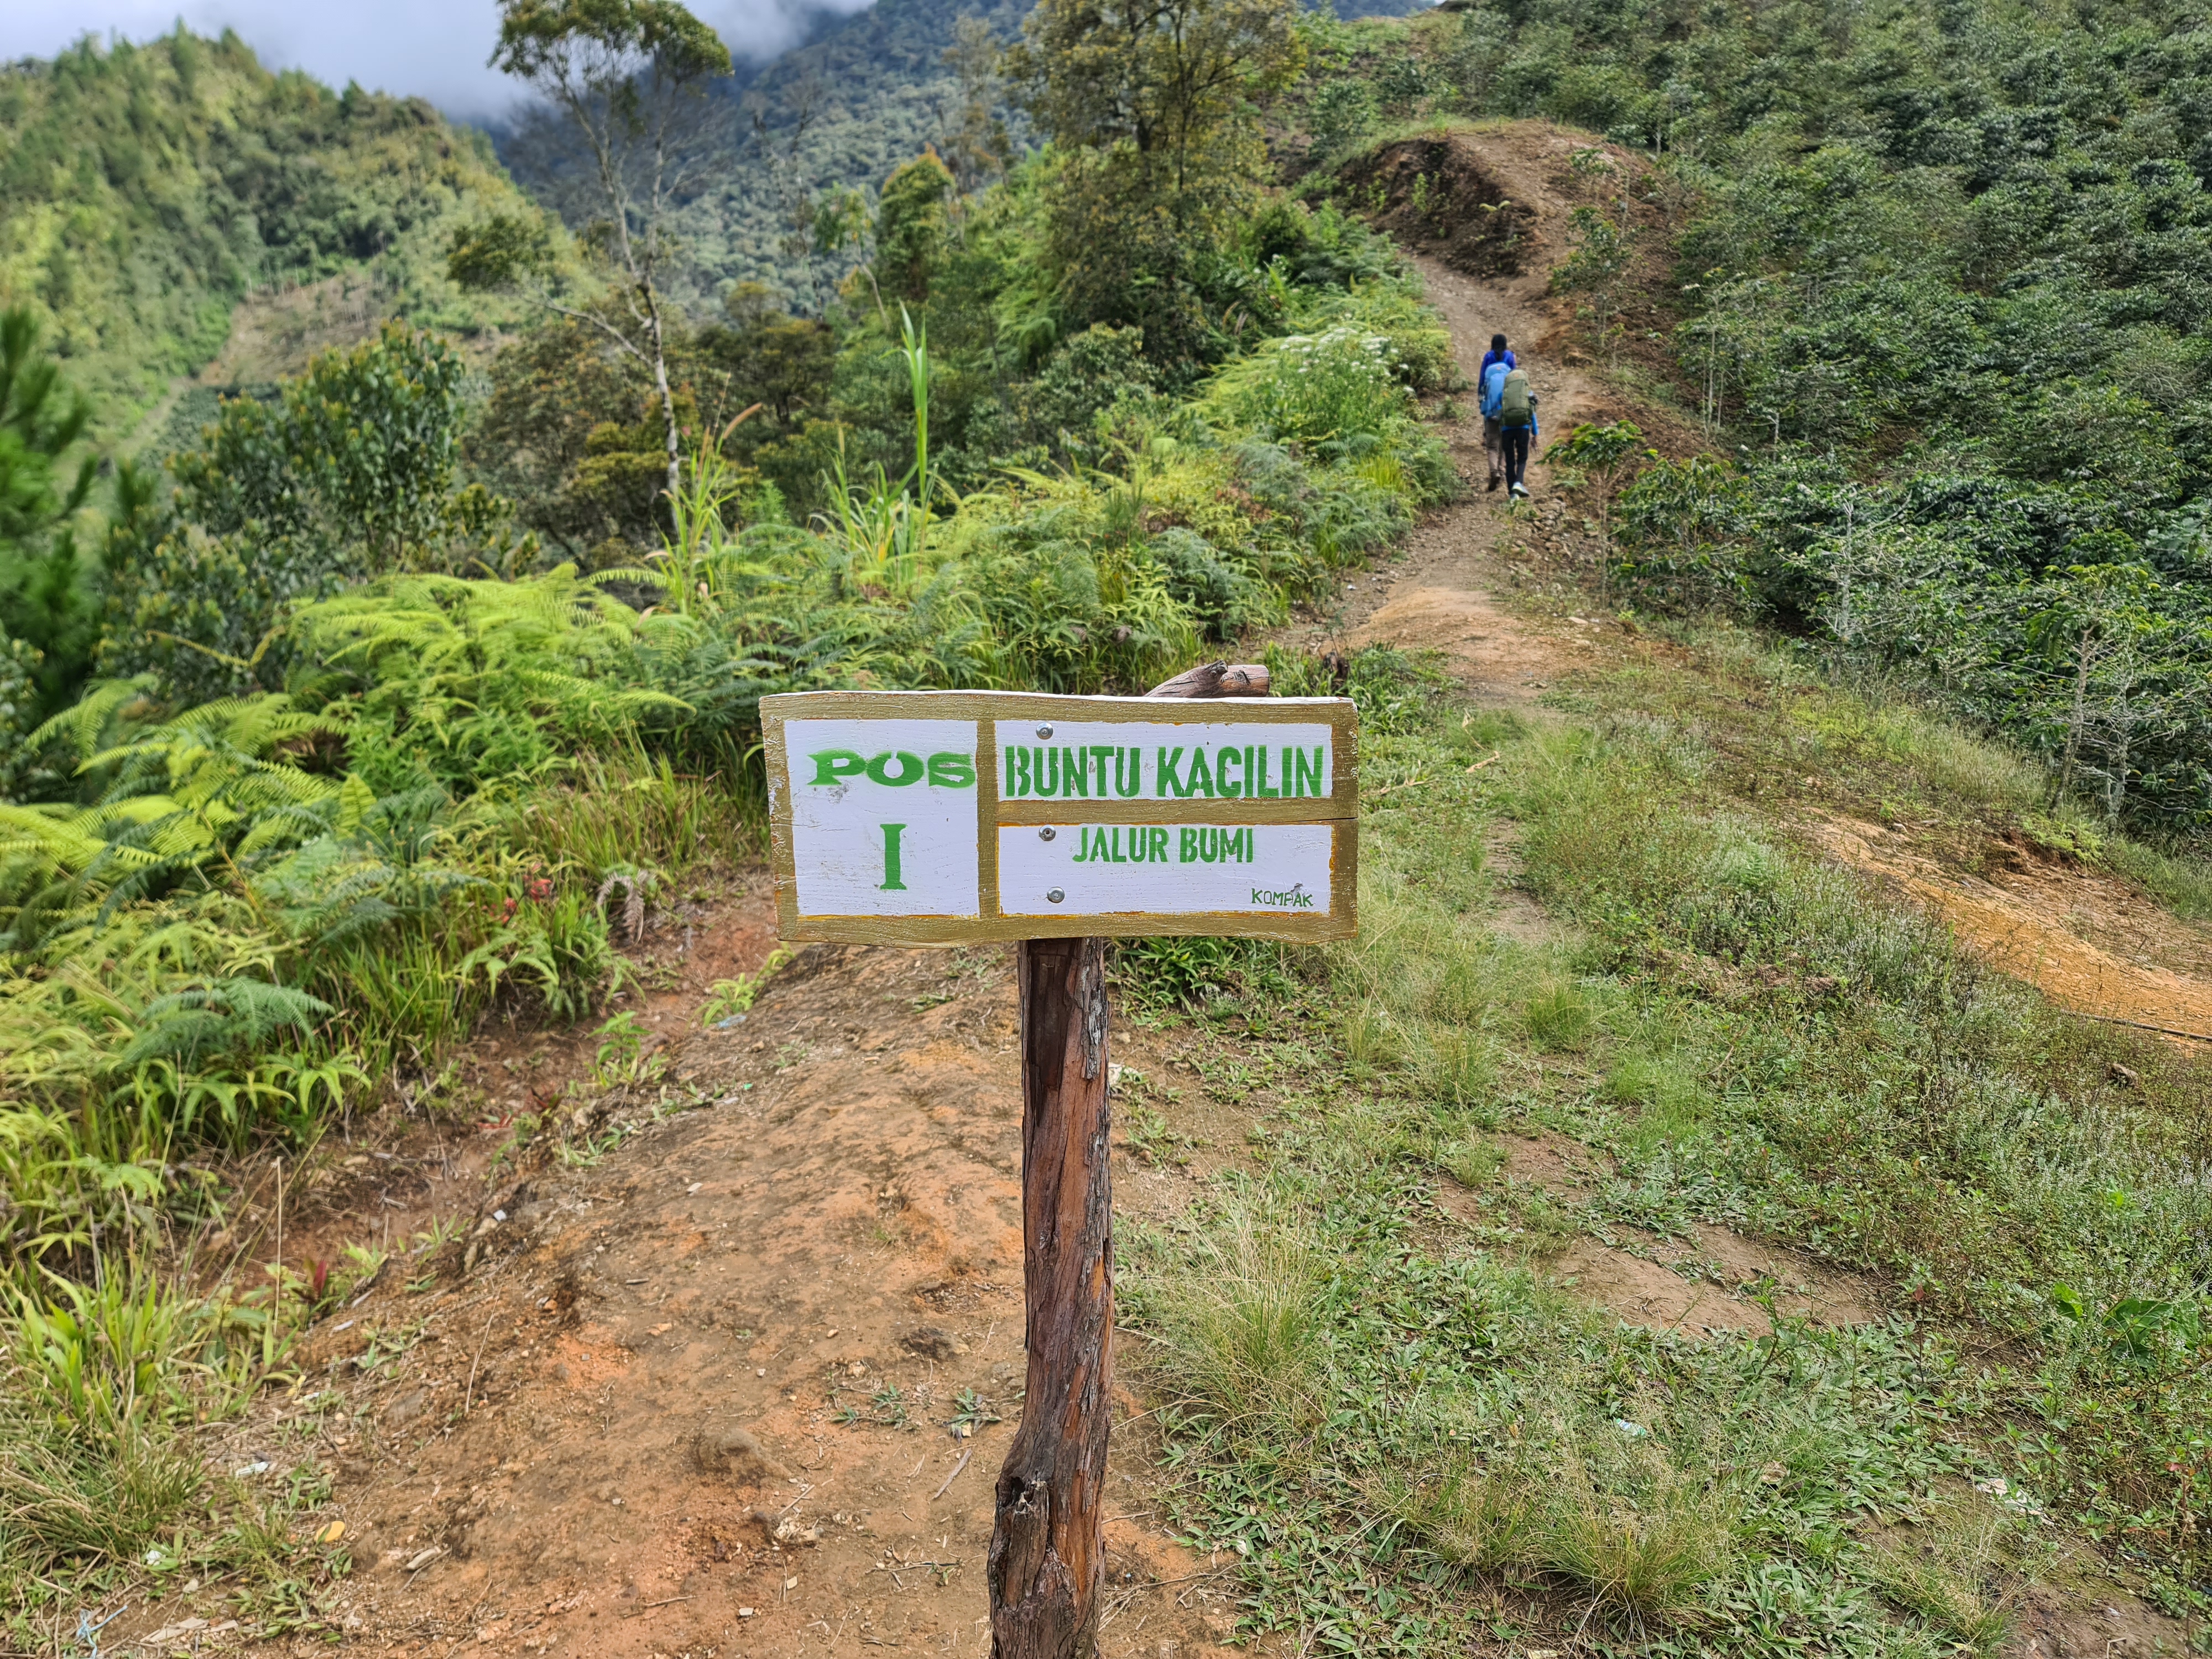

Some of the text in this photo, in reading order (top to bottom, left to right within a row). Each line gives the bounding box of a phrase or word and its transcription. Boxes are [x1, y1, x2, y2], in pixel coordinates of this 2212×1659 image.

[806, 748, 976, 789] POS
[1005, 745, 1324, 798] BUNTU KACILIN
[1072, 827, 1254, 863] JALUR BUMI
[1251, 888, 1314, 907] KOMPAK
